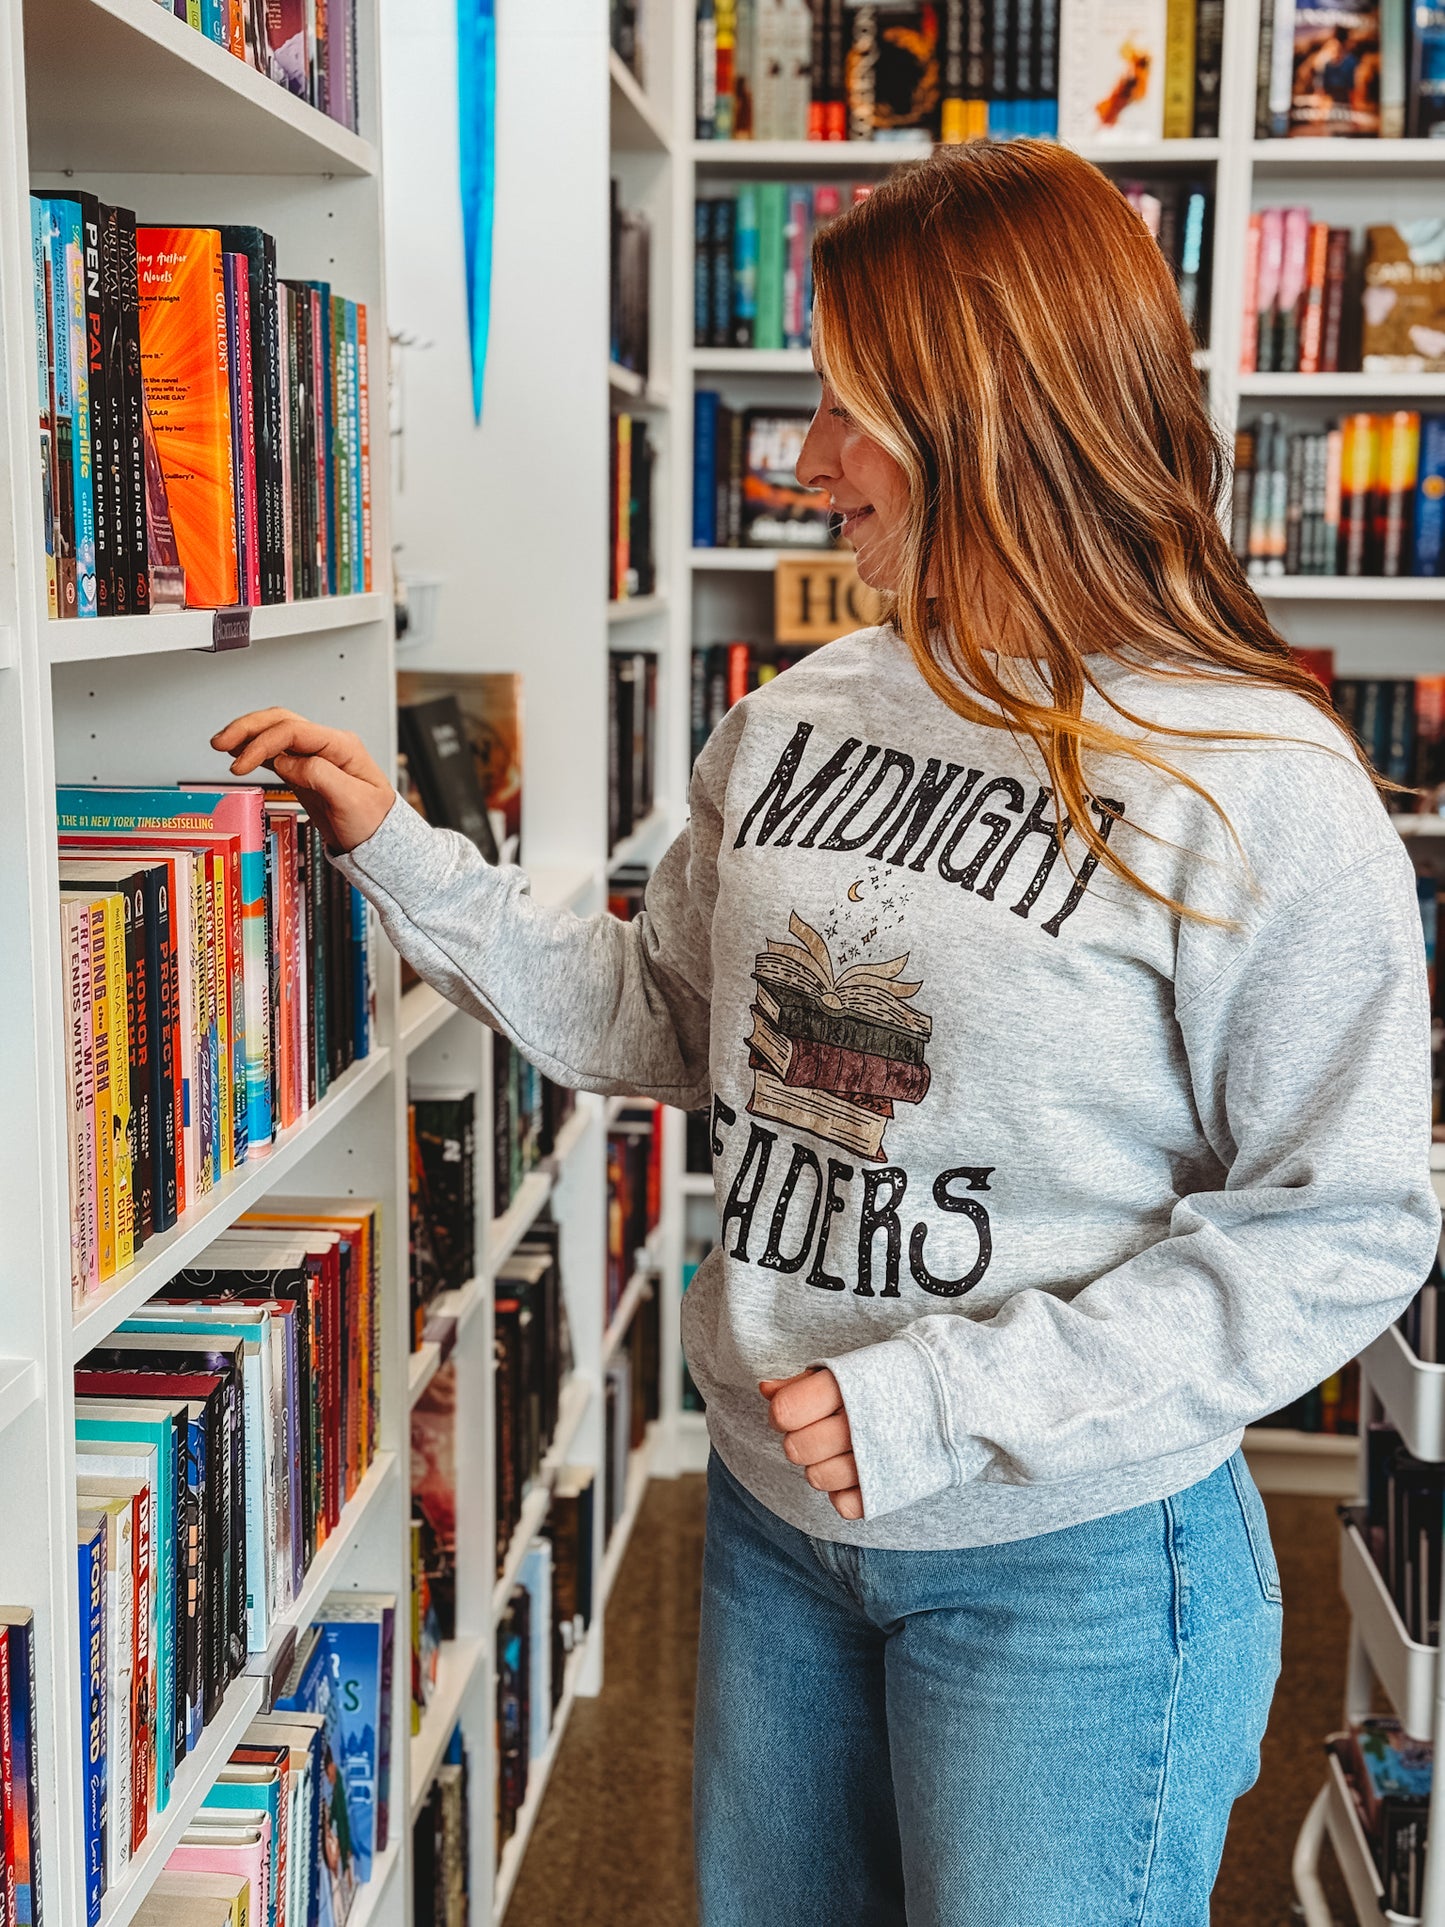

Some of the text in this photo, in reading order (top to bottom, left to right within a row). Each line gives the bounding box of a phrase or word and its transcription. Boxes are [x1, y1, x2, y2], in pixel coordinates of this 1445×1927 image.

[86, 222, 100, 374] PEN PAL
[108, 220, 119, 306] BRUTAL
[120, 230, 130, 312] HEARTS
[129, 232, 138, 312] SAVAGE
[143, 270, 173, 283] Novels
[157, 252, 187, 265] Author
[73, 259, 91, 479] Love Afterlife
[215, 292, 228, 373] GUILLORY
[95, 440, 105, 550] GEISSINGER
[113, 439, 123, 556] GEISSINGER
[132, 437, 143, 552] GEISSINGER
[62, 815, 76, 826] THE
[91, 815, 110, 826] NEW
[113, 816, 135, 827] YORK
[138, 818, 160, 828] TIMES
[162, 817, 213, 829] BESTSELLING
[732, 721, 1126, 938] MIDNIGHT
[92, 910, 106, 1000] RIDING
[207, 946, 215, 1018] HUNTING
[217, 907, 225, 1016] COMPLICATED
[232, 947, 241, 1040] JIMENEZ
[286, 948, 293, 983] JO
[71, 926, 84, 1112] IT ENDS WITH US
[113, 936, 124, 1107] HELENA HUNTING
[126, 972, 136, 1067] FIGHT
[136, 958, 147, 1068] HONOR
[160, 940, 172, 1080] PROTECT
[96, 1033, 109, 1093] HIGH
[90, 1544, 100, 1614] FOR
[118, 1559, 128, 1646] playboy
[138, 1493, 150, 1662] DEJA BREW
[164, 1555, 173, 1608] LITTLE
[1, 1641, 10, 1752] EVERYTHING
[90, 1774, 100, 1876] Emma Lord
[35, 1849, 43, 1915] CHLOE
